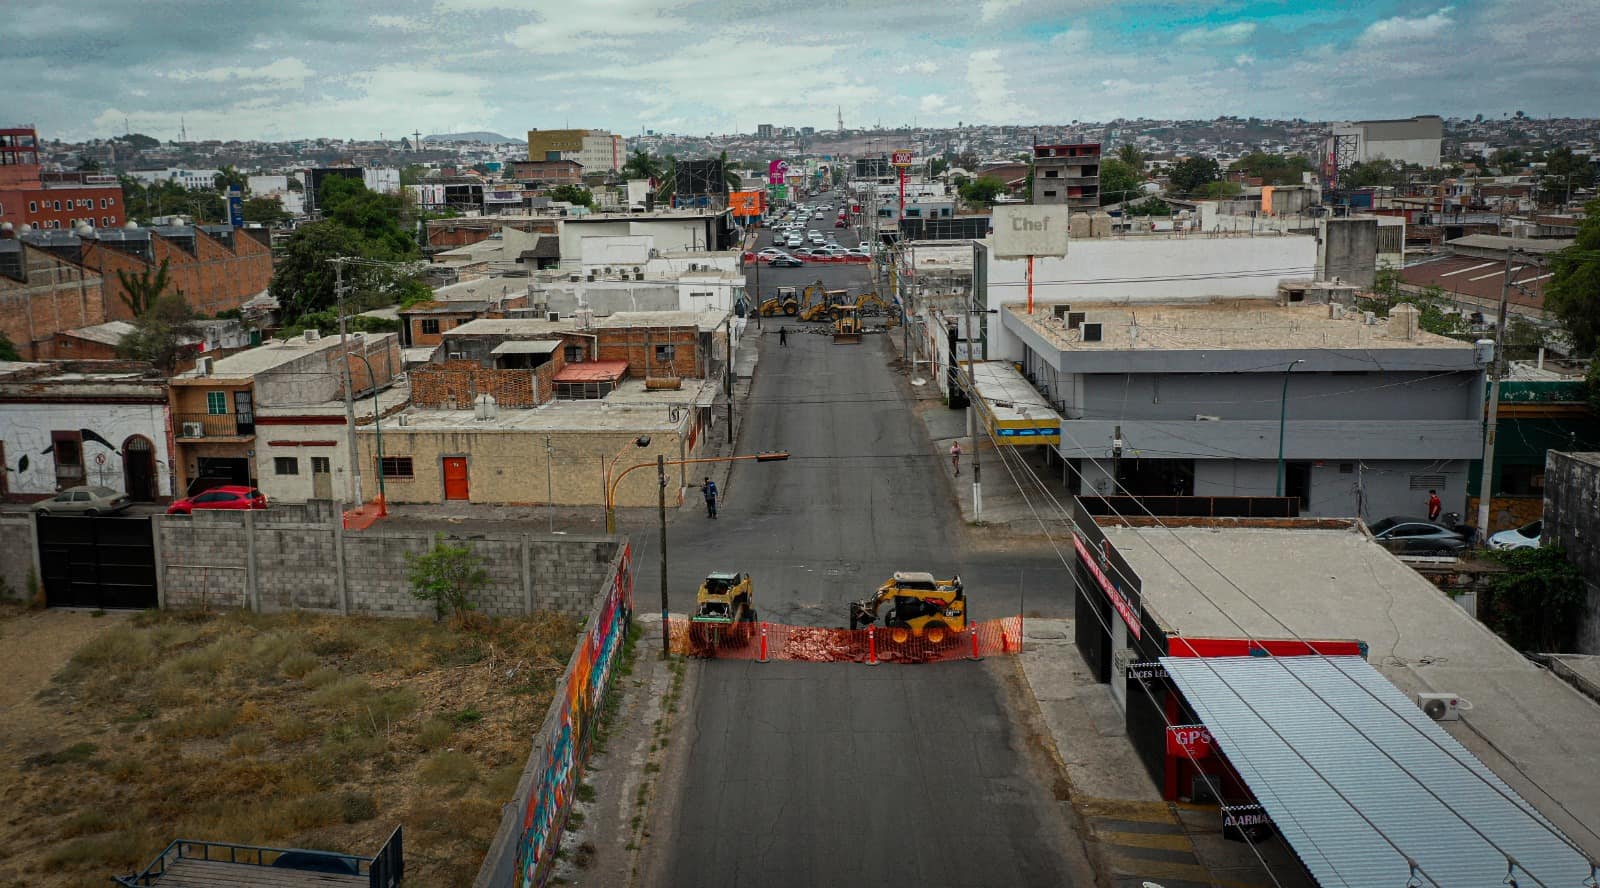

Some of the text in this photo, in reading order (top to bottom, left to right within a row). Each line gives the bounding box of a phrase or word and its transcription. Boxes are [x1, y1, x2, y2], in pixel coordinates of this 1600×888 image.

[1012, 216, 1050, 231] Chef
[1128, 670, 1153, 679] LUCES
[1175, 730, 1211, 745] GPS
[1224, 814, 1272, 826] ALARMA
